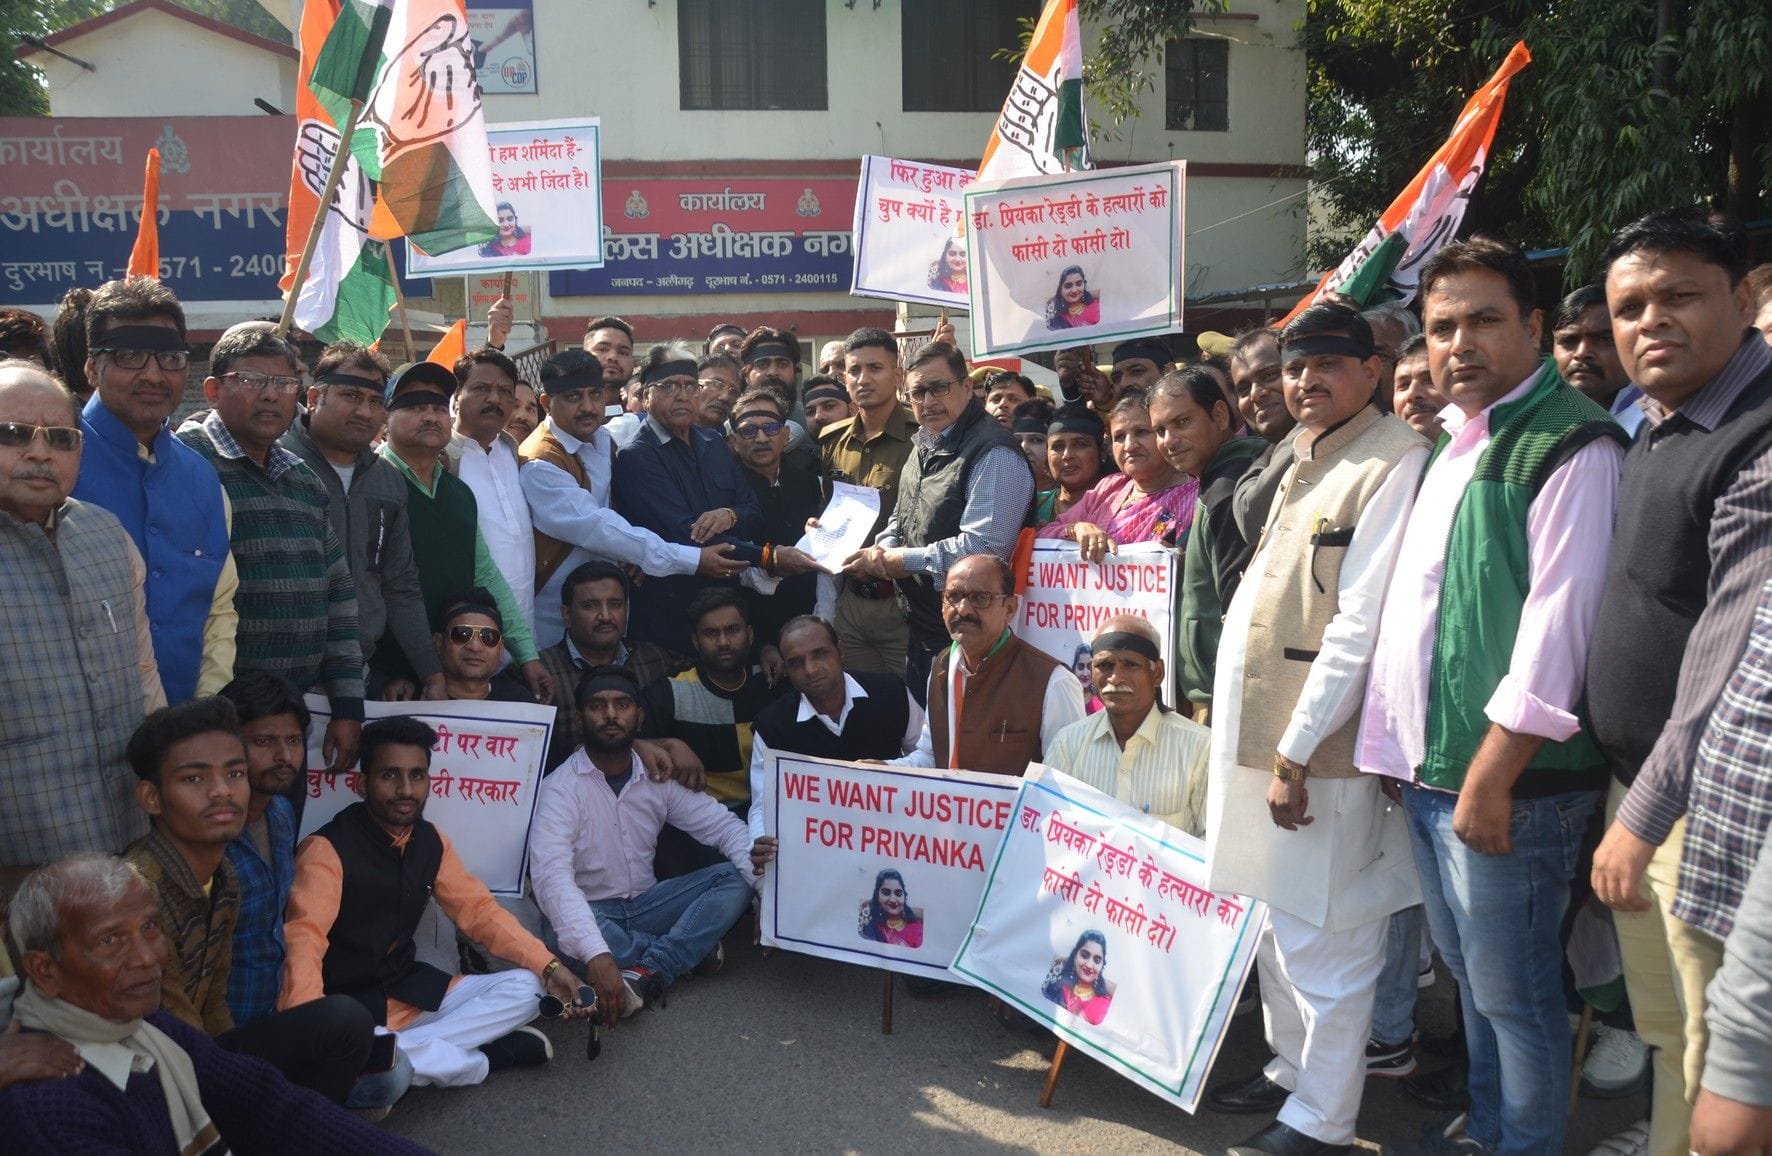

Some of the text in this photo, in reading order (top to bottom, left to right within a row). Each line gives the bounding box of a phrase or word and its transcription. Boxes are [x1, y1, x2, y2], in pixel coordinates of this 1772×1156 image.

[512, 71, 528, 84] COP
[499, 146, 519, 164] हम
[508, 171, 538, 192] अभी
[540, 169, 571, 191] जिंदा
[890, 159, 919, 188] फिर
[920, 168, 956, 193] हुआ
[186, 192, 282, 230] नगर
[679, 187, 766, 211] कार्यालय
[878, 198, 903, 222] चुप
[907, 198, 936, 223] क्यों
[939, 199, 952, 227] है
[999, 200, 1044, 228] प्रियंका
[1085, 192, 1099, 217] के
[1103, 186, 1145, 217] हत्यारों
[1149, 184, 1167, 208] को
[668, 222, 795, 260] अधीक्षक
[802, 230, 854, 257] नग
[1012, 235, 1048, 263] फांसी
[1052, 234, 1067, 257] दो
[1071, 228, 1106, 256] फांसी
[158, 256, 201, 279] 571
[230, 254, 286, 278] 2400
[611, 277, 644, 288] जनपद
[761, 274, 785, 284] 0571
[795, 273, 838, 284] 2400115
[1040, 562, 1088, 590] WANT
[1095, 564, 1166, 593] JUSTICE
[1026, 601, 1060, 630] FOR
[457, 734, 482, 760] पर
[485, 736, 518, 763] वार
[458, 777, 521, 806] सरकार
[784, 772, 1011, 830] WE WANT JUSTICE
[805, 817, 985, 872] FOR PRIYANKA
[1047, 810, 1096, 860] प्रियंका
[1138, 854, 1158, 888] के
[1216, 894, 1243, 930] को
[1043, 866, 1083, 904] फांसी
[1084, 880, 1104, 915] दो
[1106, 896, 1147, 937] फांसी
